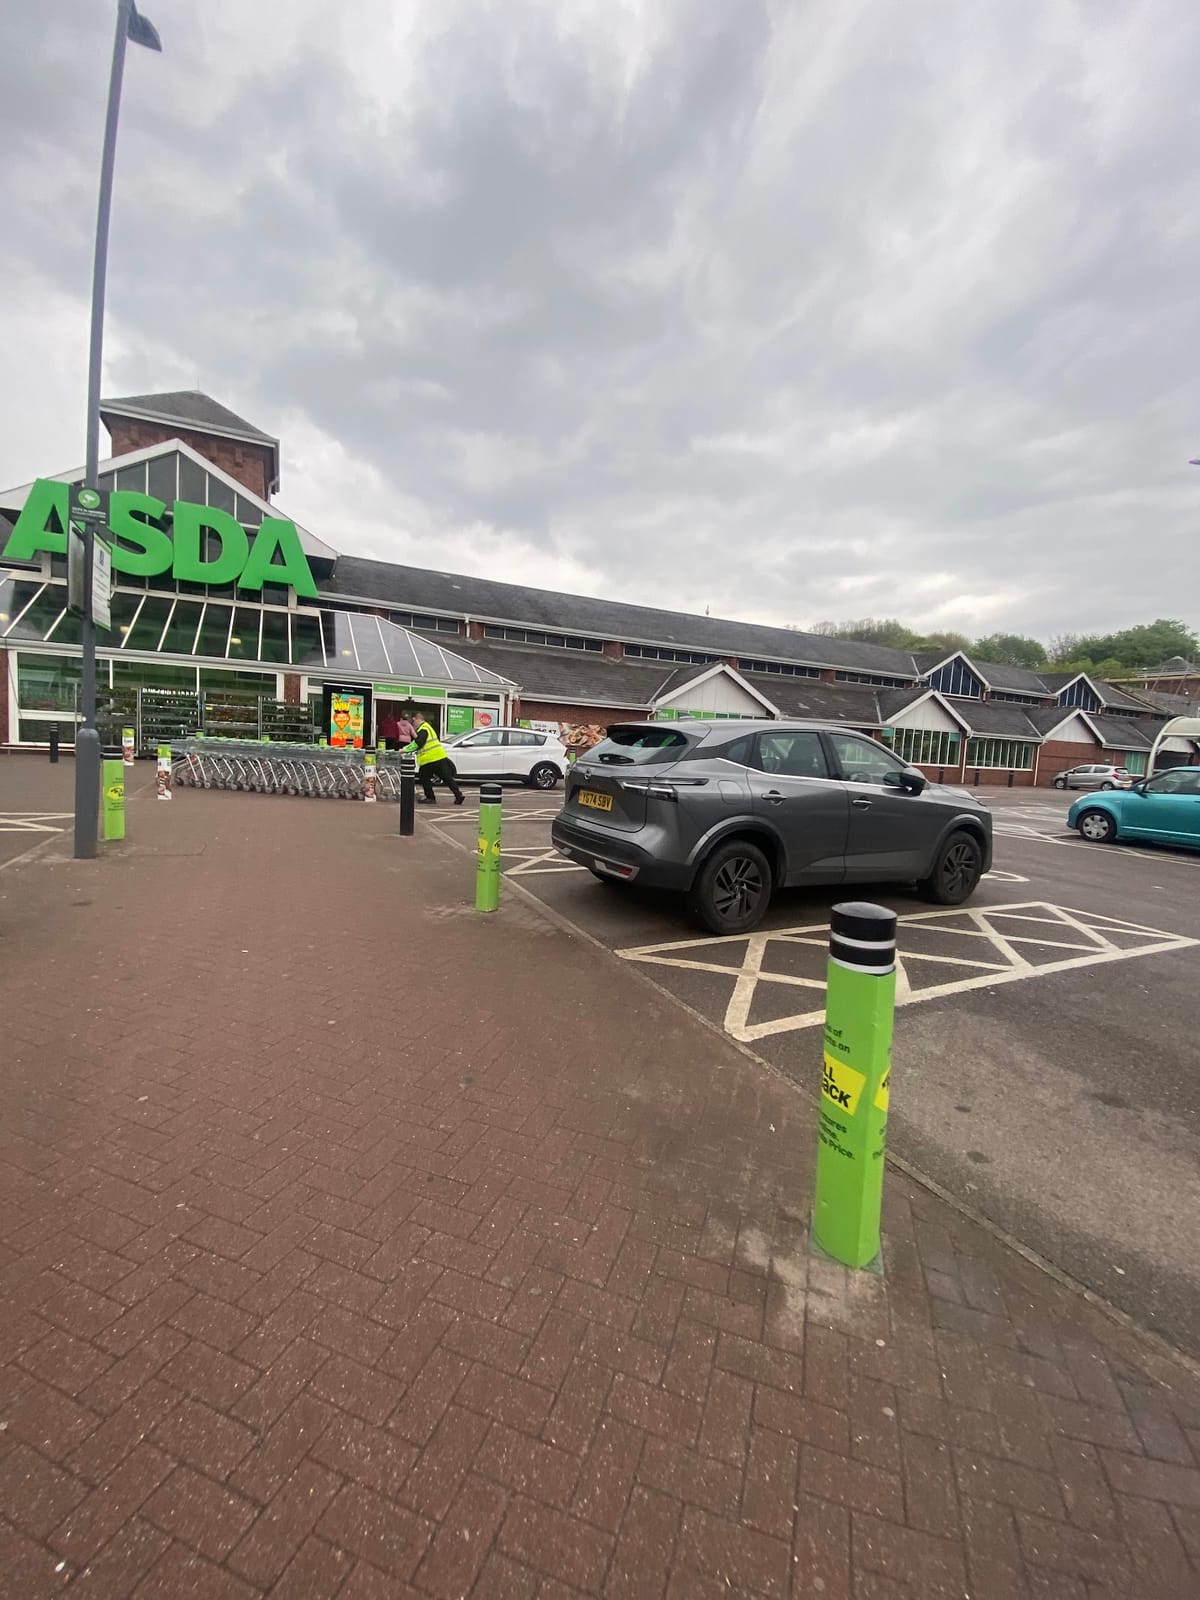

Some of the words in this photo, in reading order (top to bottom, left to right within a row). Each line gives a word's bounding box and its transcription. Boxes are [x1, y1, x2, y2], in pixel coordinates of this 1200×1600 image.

[1, 478, 320, 599] ASDA
[838, 1043, 850, 1054] on
[823, 1061, 836, 1083] LL
[822, 1077, 852, 1109] ACK
